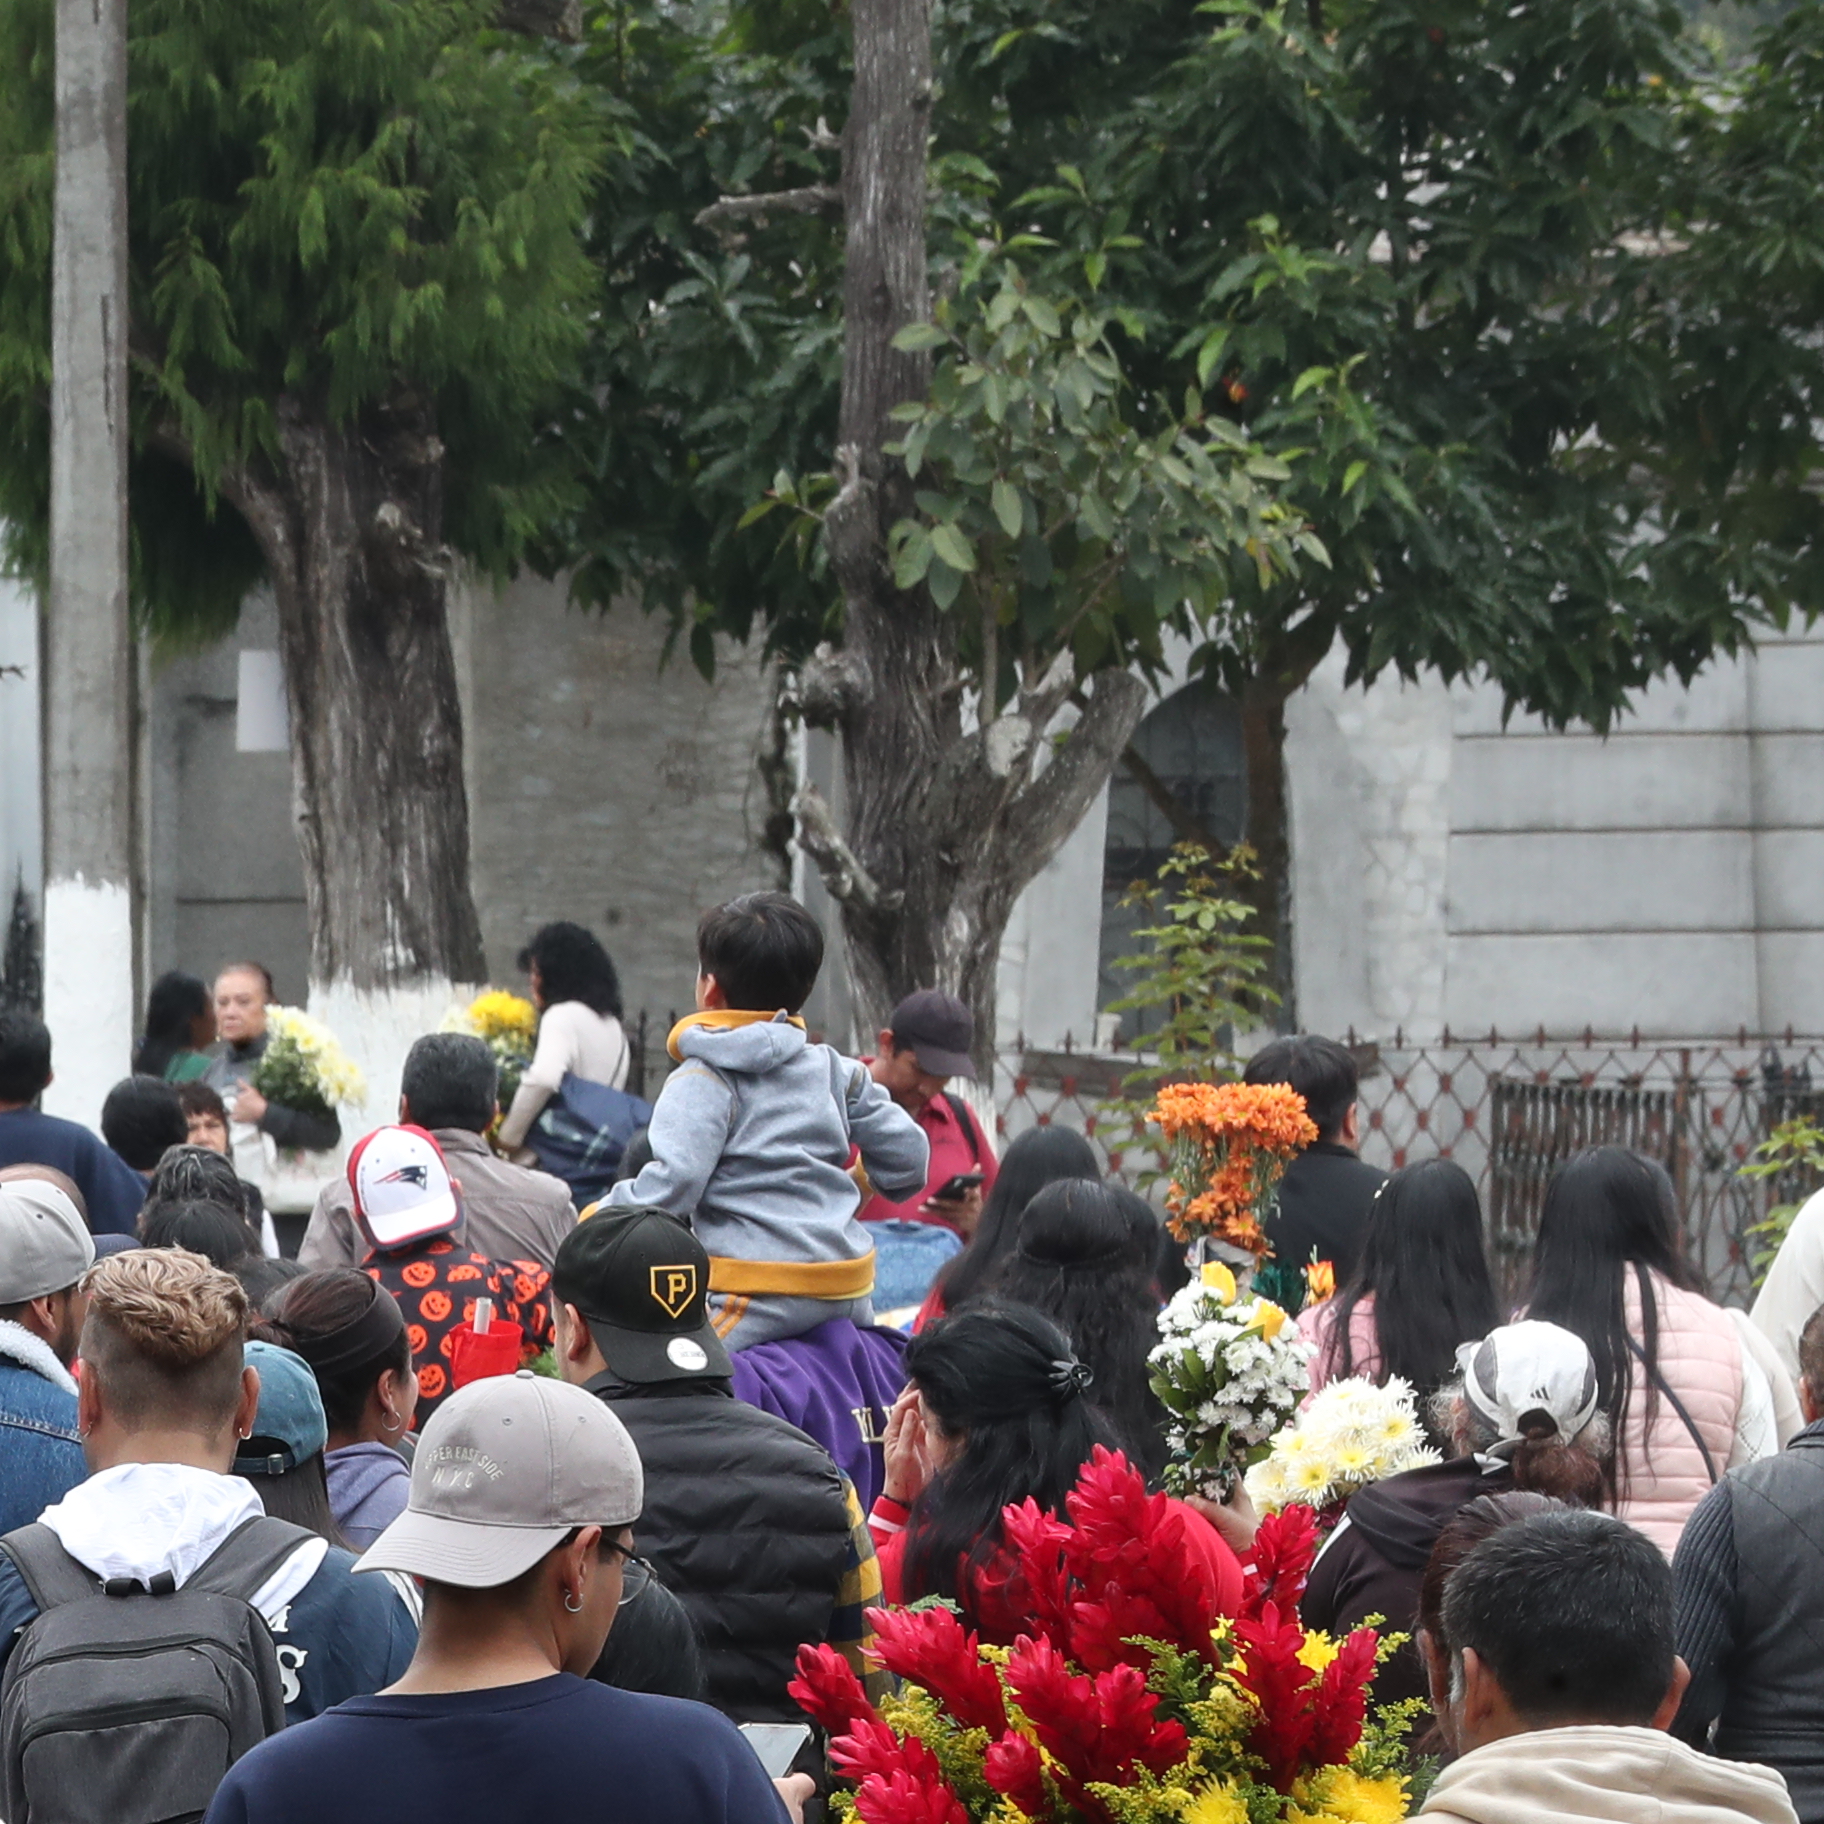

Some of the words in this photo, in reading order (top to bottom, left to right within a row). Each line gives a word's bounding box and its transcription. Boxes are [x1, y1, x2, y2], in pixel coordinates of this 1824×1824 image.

[667, 1272, 687, 1305] P
[455, 1446, 481, 1463] EAST
[477, 1454, 504, 1481] SIDE
